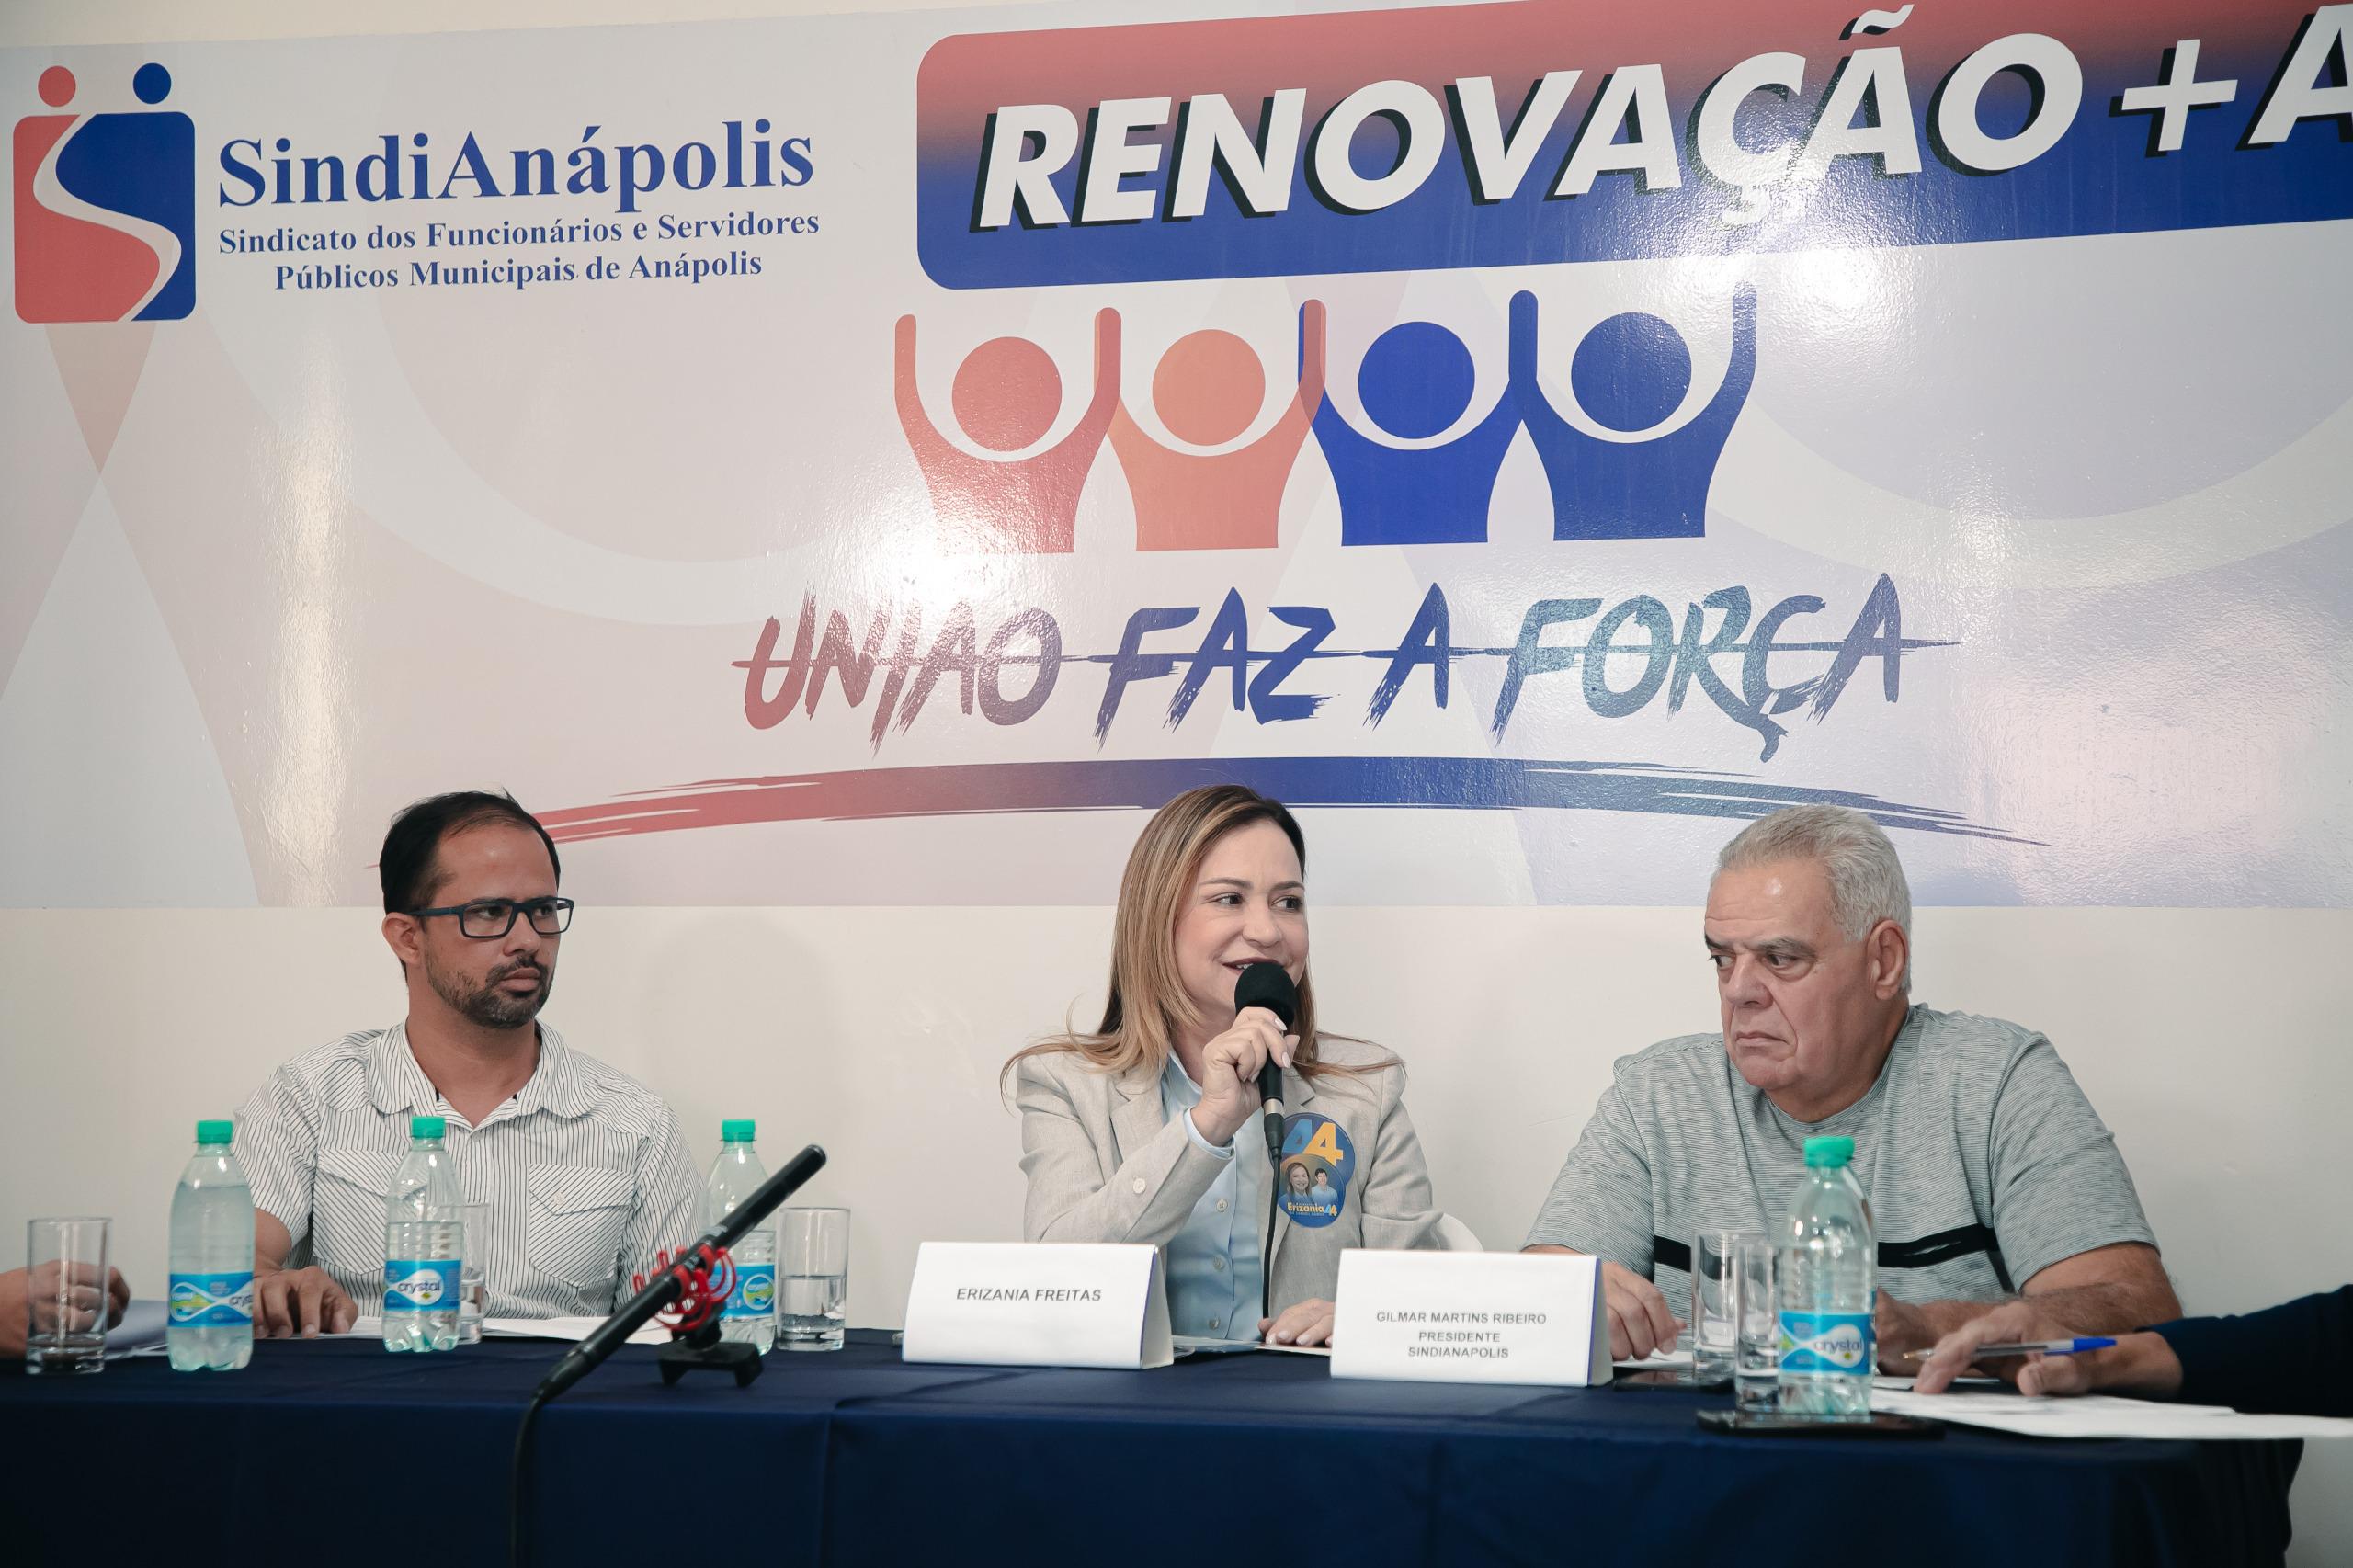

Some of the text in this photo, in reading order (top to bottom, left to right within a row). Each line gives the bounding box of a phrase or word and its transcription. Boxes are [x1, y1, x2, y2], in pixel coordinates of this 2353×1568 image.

[971, 4, 2084, 232] RENOVAÇÃO
[219, 118, 813, 213] SindiAnápolis
[219, 211, 820, 254] Sindicato dos Funcionários e Servidores
[275, 249, 763, 290] Públicos Municipais de Anápolis
[1092, 586, 1343, 752] FAZ
[1363, 582, 1449, 731] A
[1491, 572, 1902, 763] FORÇA
[1287, 1202, 1324, 1212] Erizania
[397, 1279, 441, 1294] crystal
[956, 1288, 1102, 1301] ERIZANIA FREITAS
[1376, 1312, 1547, 1324] GILMAR MARTINS RIBEIRO
[1418, 1332, 1501, 1343] PRESIDENTE
[1408, 1346, 1509, 1358] SINDIANAPOLIS
[1815, 1338, 1862, 1354] crystal
